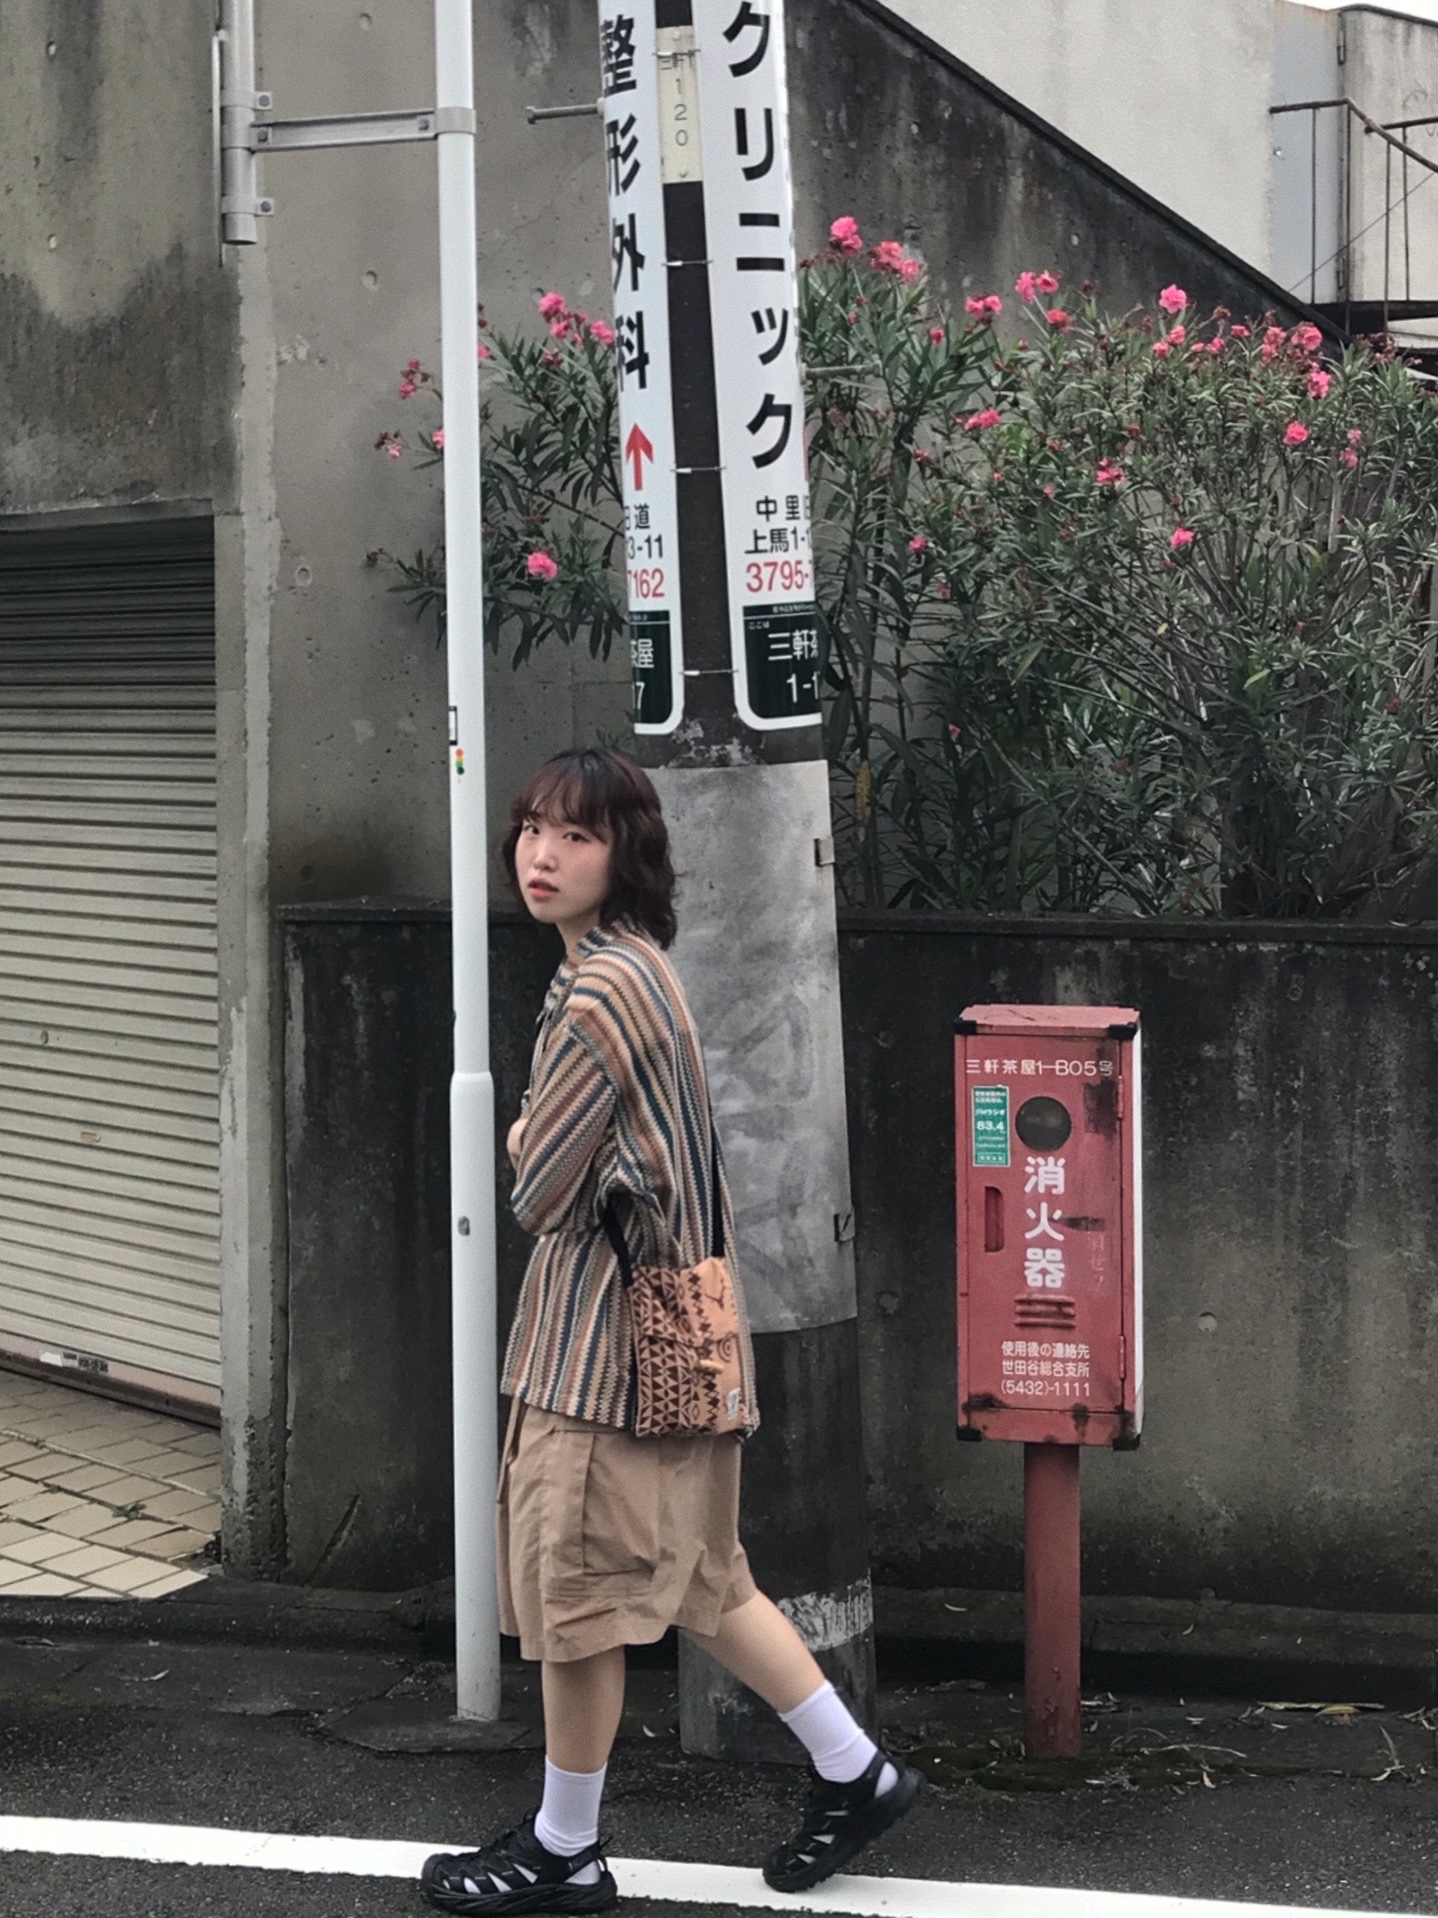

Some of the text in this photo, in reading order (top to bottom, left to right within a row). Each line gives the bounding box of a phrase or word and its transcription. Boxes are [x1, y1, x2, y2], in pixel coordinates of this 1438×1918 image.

[601, 14, 650, 391] 整形外科
[722, 1, 792, 470] クリニック
[744, 526, 811, 554] 上馬1-
[1024, 1156, 1066, 1288] 消火器
[1001, 1340, 1091, 1360] 使用後の連絡先
[1001, 1359, 1091, 1378] 世田谷総合支所
[1000, 1379, 1091, 1397] (5432)-1111
